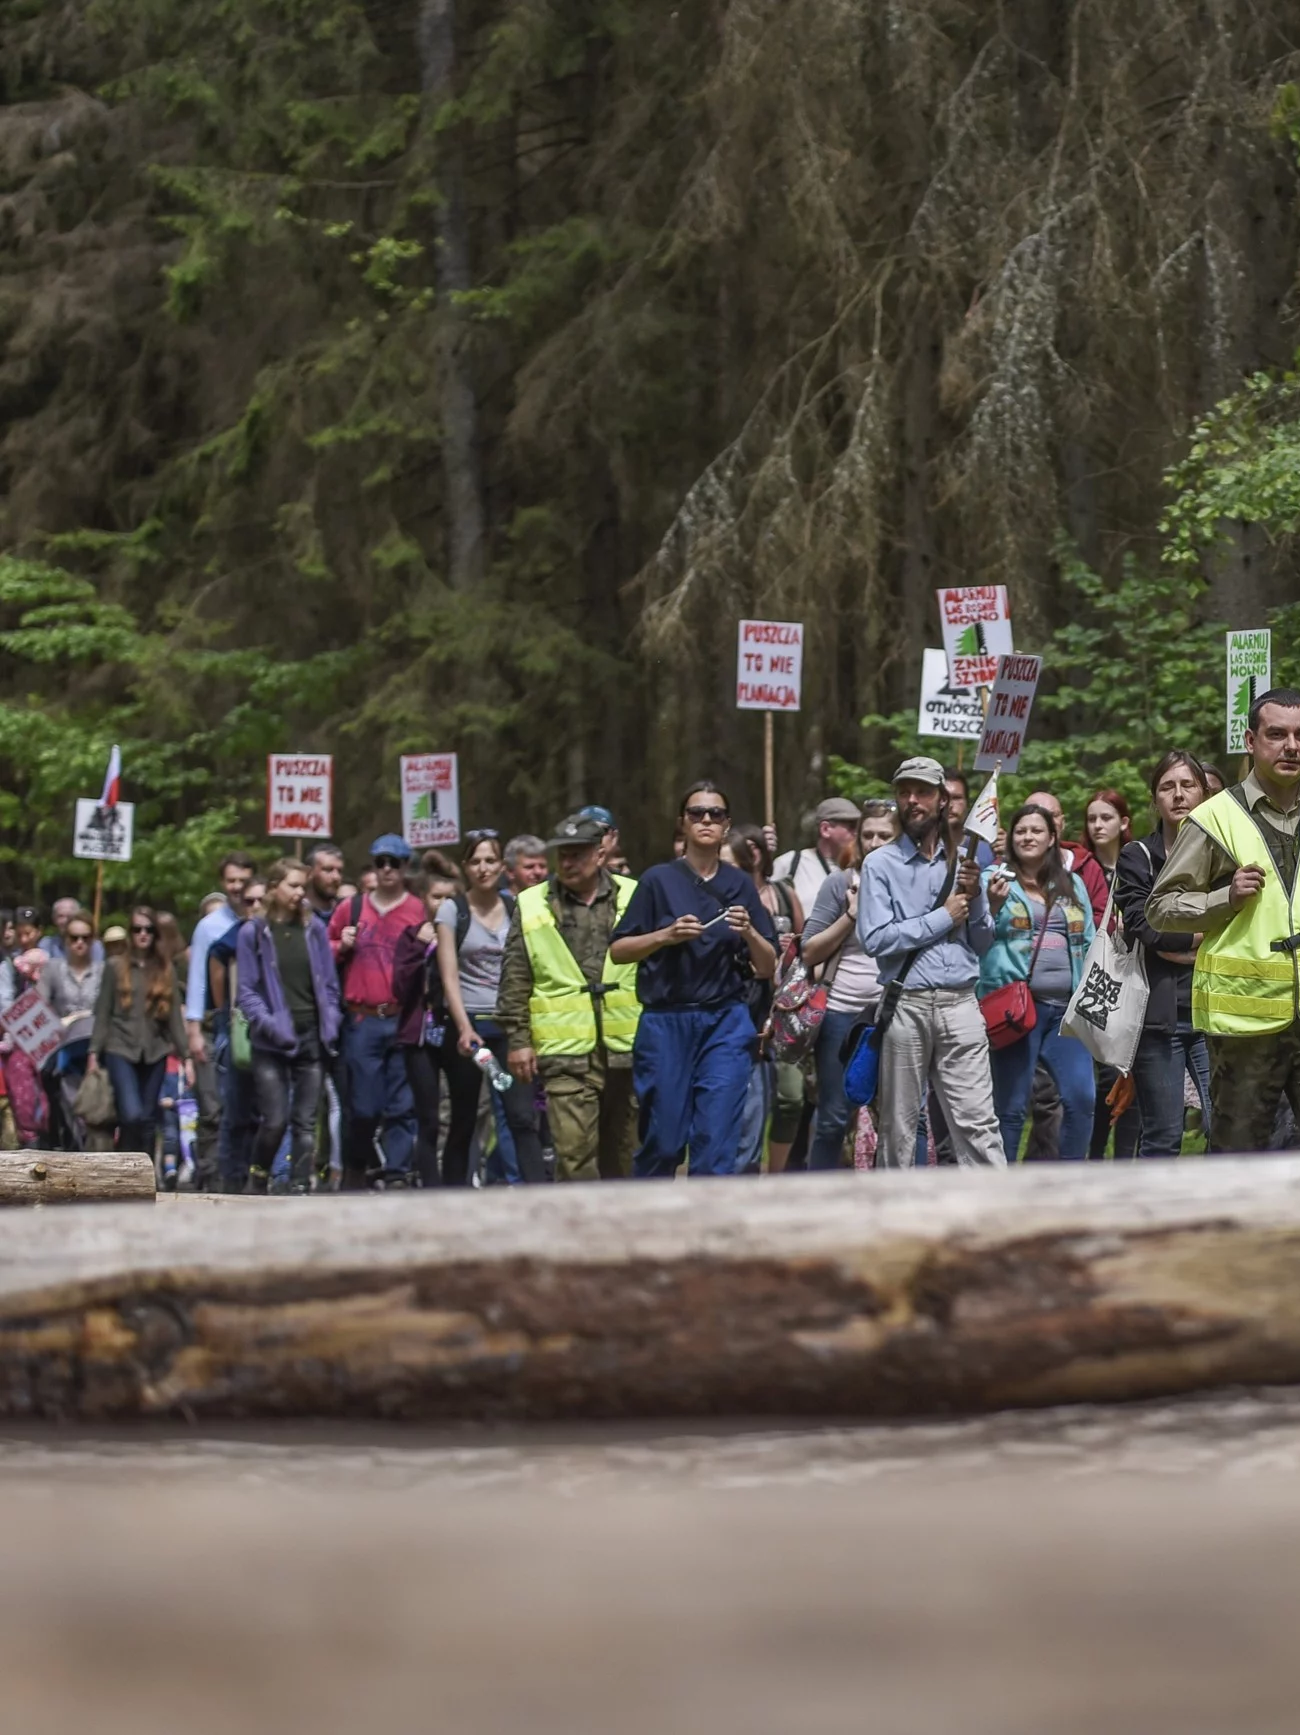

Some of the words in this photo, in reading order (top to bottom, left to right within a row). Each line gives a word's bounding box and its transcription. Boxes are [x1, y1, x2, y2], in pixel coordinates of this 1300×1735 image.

[945, 585, 997, 603] ALARMUJ
[945, 602, 964, 616] LAS
[946, 612, 999, 625] WOLNO
[744, 623, 801, 645] PUSZCZA
[1230, 632, 1269, 651] ALARMUJ
[743, 652, 763, 671] TO
[769, 655, 795, 674] NIE
[954, 656, 996, 672] ZNIK
[1230, 652, 1243, 665] LAS
[954, 669, 996, 686] SZYBK
[1001, 656, 1038, 682] PUSZCZA
[1230, 664, 1268, 678] WOLNO
[926, 699, 984, 717] OTWÓRZC
[994, 692, 1009, 717] TO
[1009, 694, 1029, 719] NIE
[932, 717, 985, 734] PUSZCZ
[277, 785, 295, 803] TO
